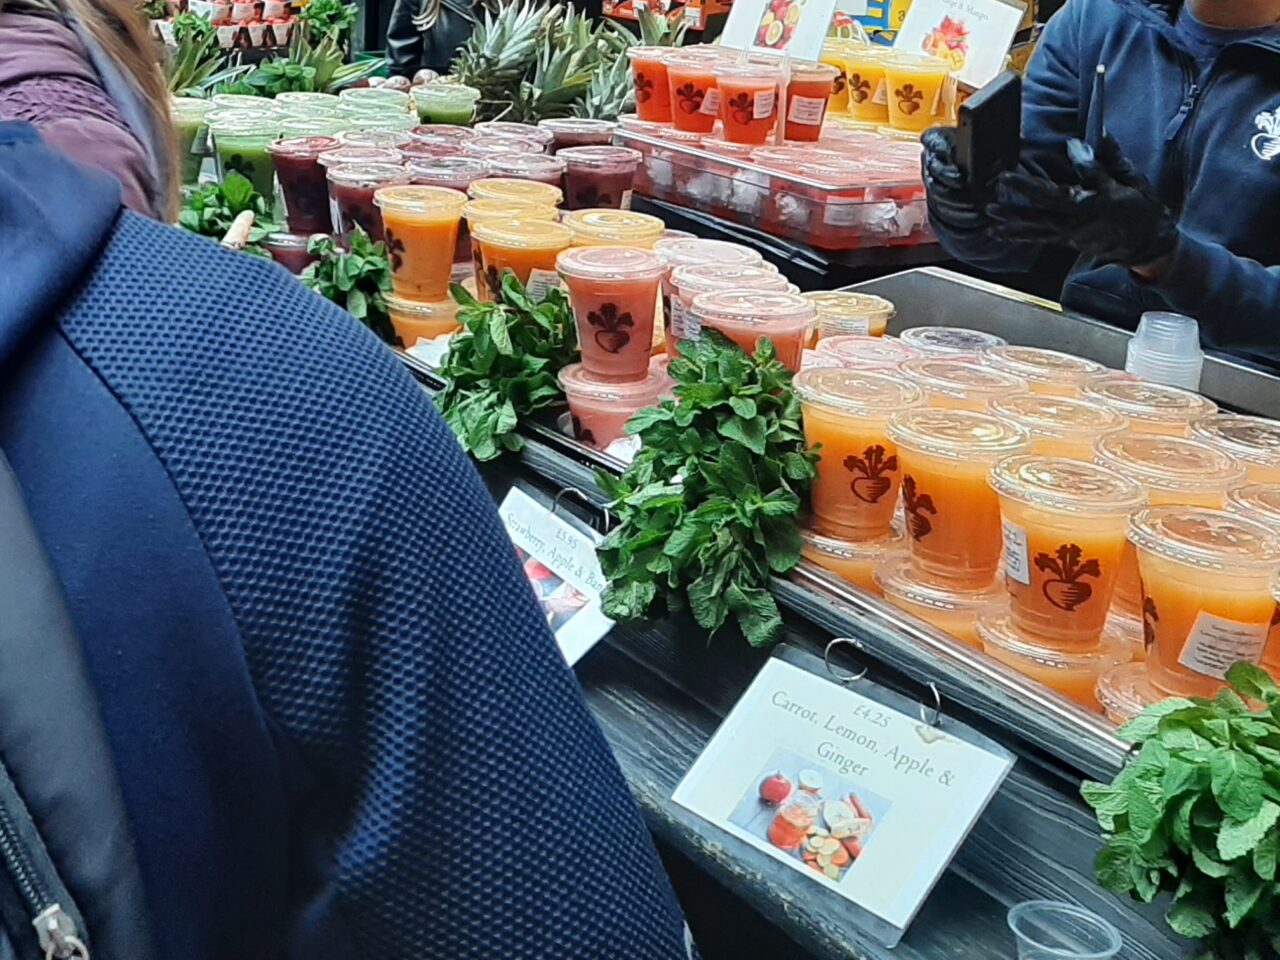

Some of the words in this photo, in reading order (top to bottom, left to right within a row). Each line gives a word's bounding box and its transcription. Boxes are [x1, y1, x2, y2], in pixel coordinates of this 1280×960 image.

[505, 513, 545, 554] Strawberry,
[547, 547, 575, 570] Apple
[575, 565, 587, 578] &
[584, 572, 604, 592] Ban
[771, 690, 818, 724] Carrot,
[824, 714, 879, 754] Lemon,
[884, 745, 935, 778] Apple
[938, 770, 956, 787] &
[853, 703, 893, 728] £4.25
[816, 741, 869, 776] Ginger
